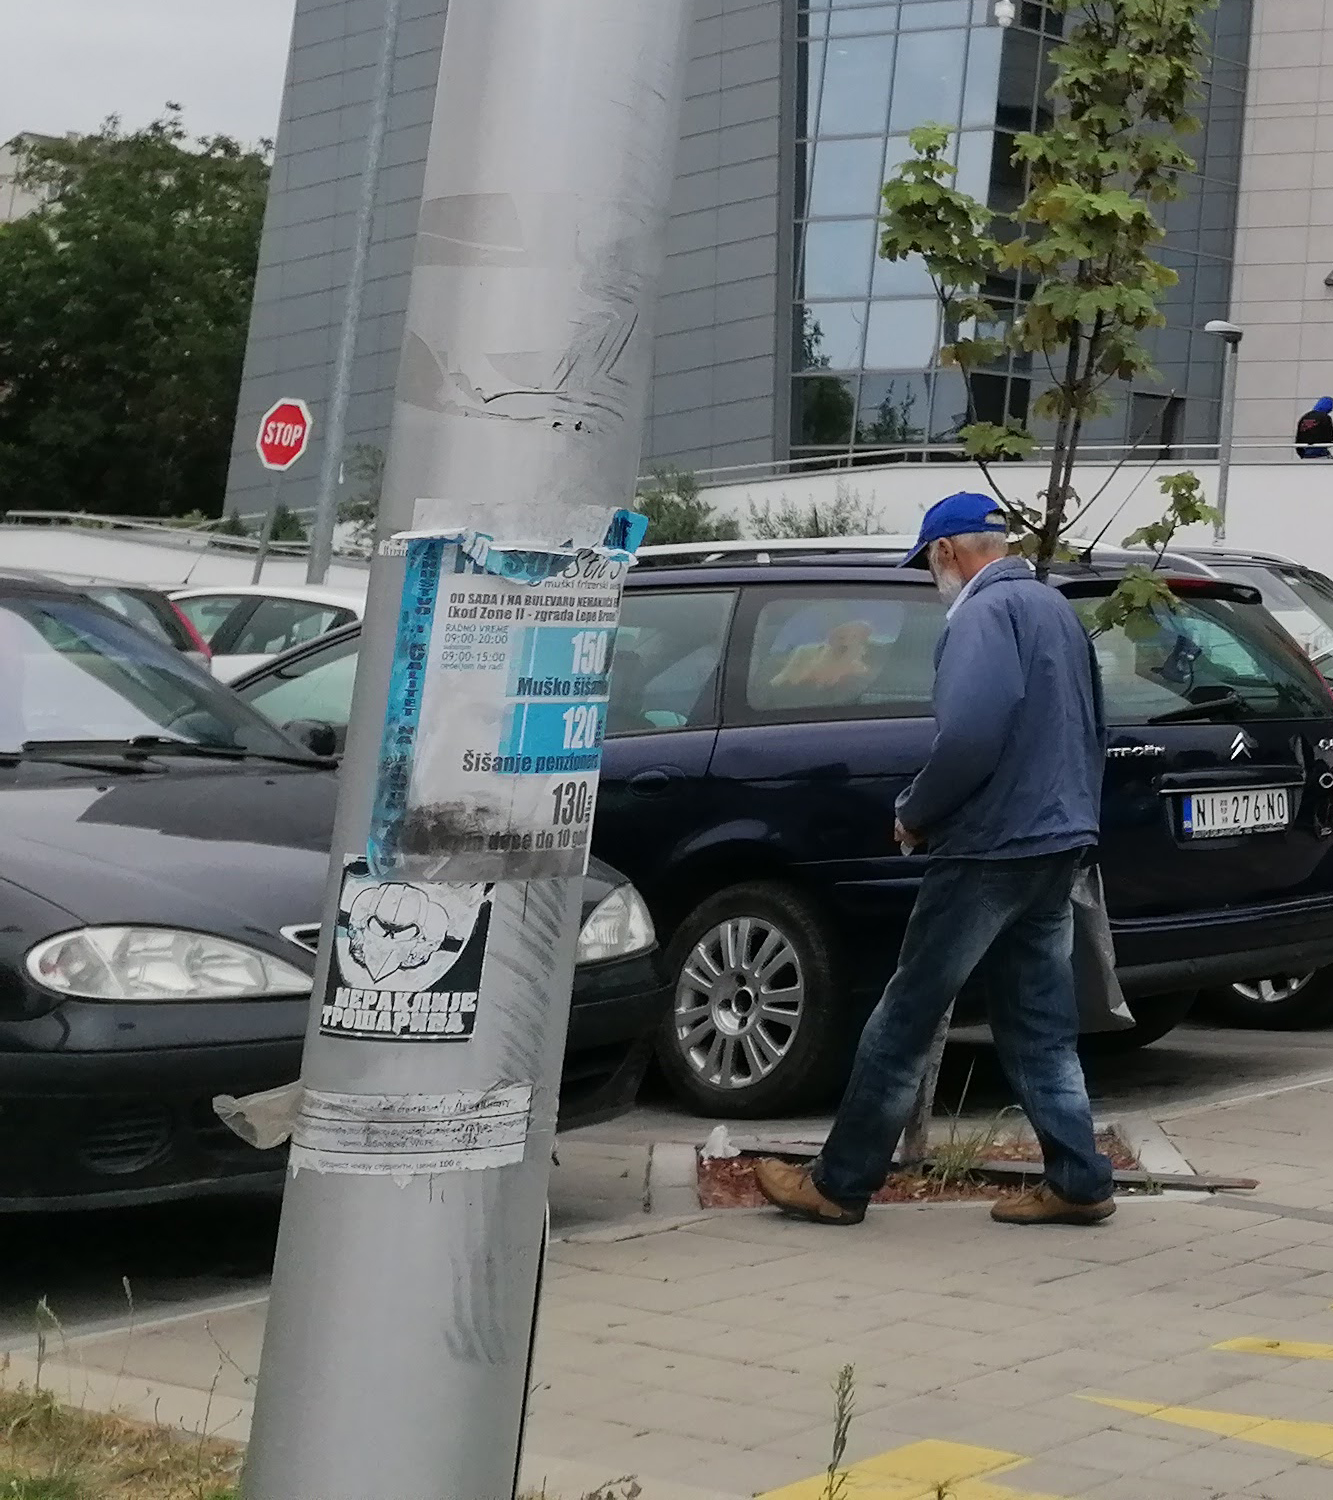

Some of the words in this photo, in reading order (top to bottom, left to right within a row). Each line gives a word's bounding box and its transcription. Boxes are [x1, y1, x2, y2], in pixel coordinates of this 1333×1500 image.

[264, 421, 303, 447] STOP
[450, 592, 465, 604] OD
[467, 593, 498, 605] SADA
[480, 607, 512, 620] Zone
[534, 609, 573, 623] zgrada
[571, 631, 608, 675] 150
[517, 677, 571, 696] Muško
[563, 705, 598, 749] 120
[462, 749, 532, 774] Šišanje
[552, 781, 587, 826] 130
[1196, 798, 1215, 826] NI
